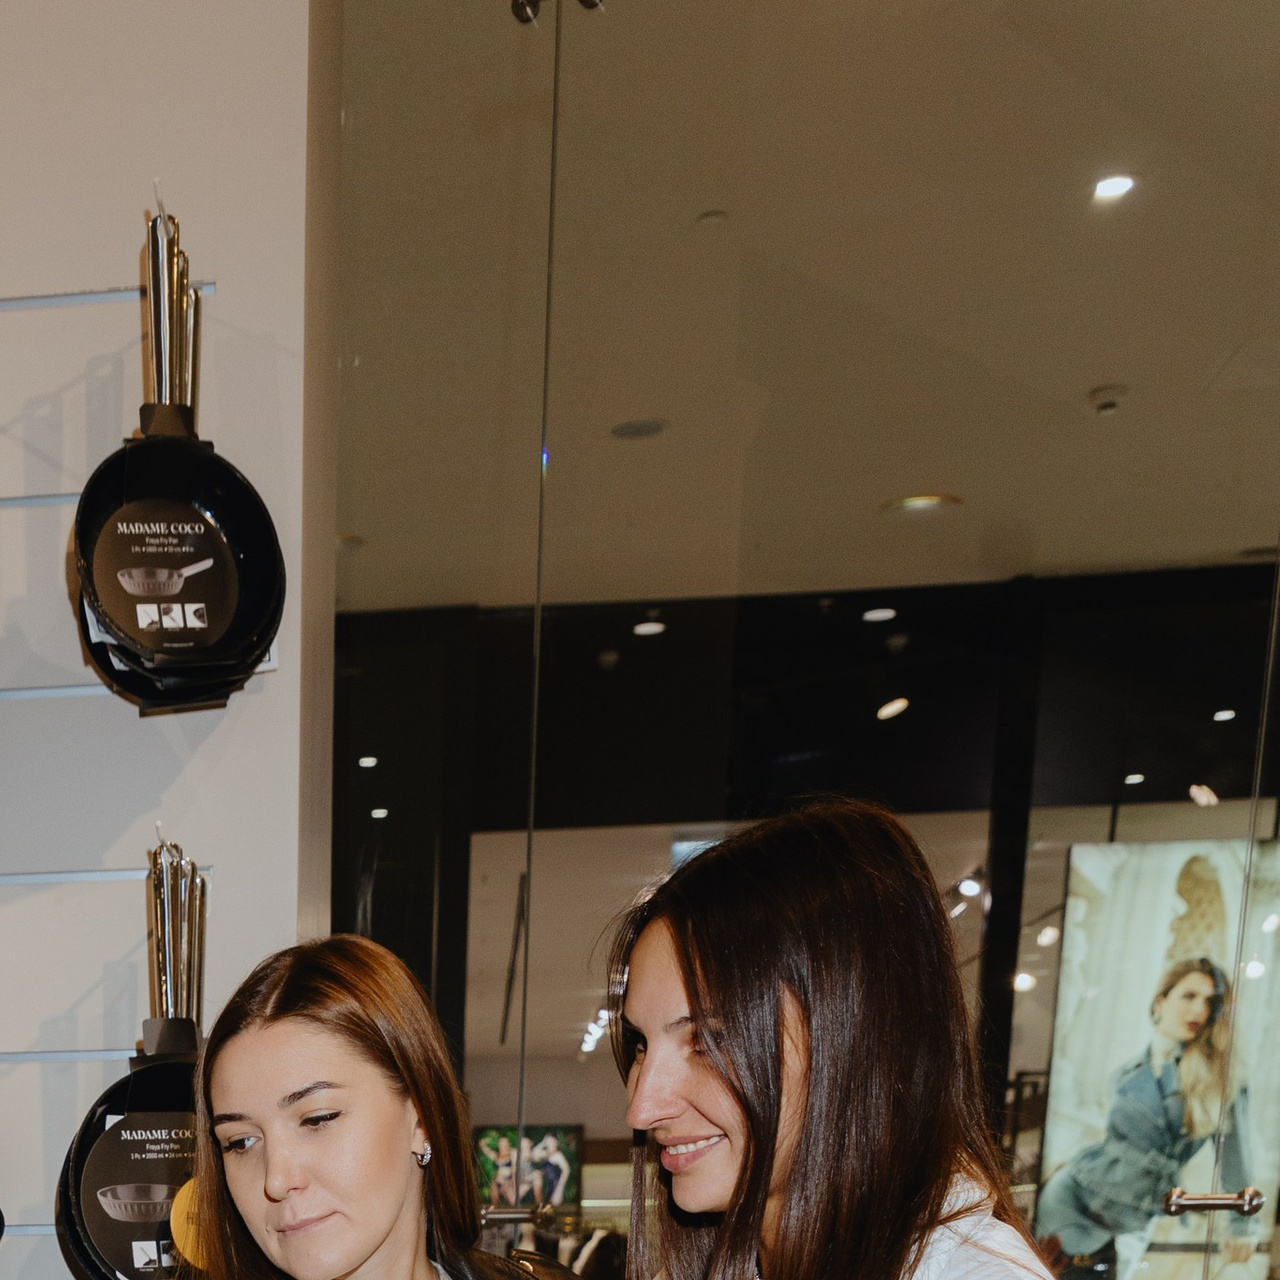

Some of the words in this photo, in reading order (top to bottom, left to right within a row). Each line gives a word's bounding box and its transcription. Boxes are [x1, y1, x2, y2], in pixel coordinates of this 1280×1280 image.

[117, 522, 169, 535] MADAME
[170, 522, 205, 535] COCO
[121, 1129, 170, 1140] MADAME
[171, 1129, 195, 1139] COC
